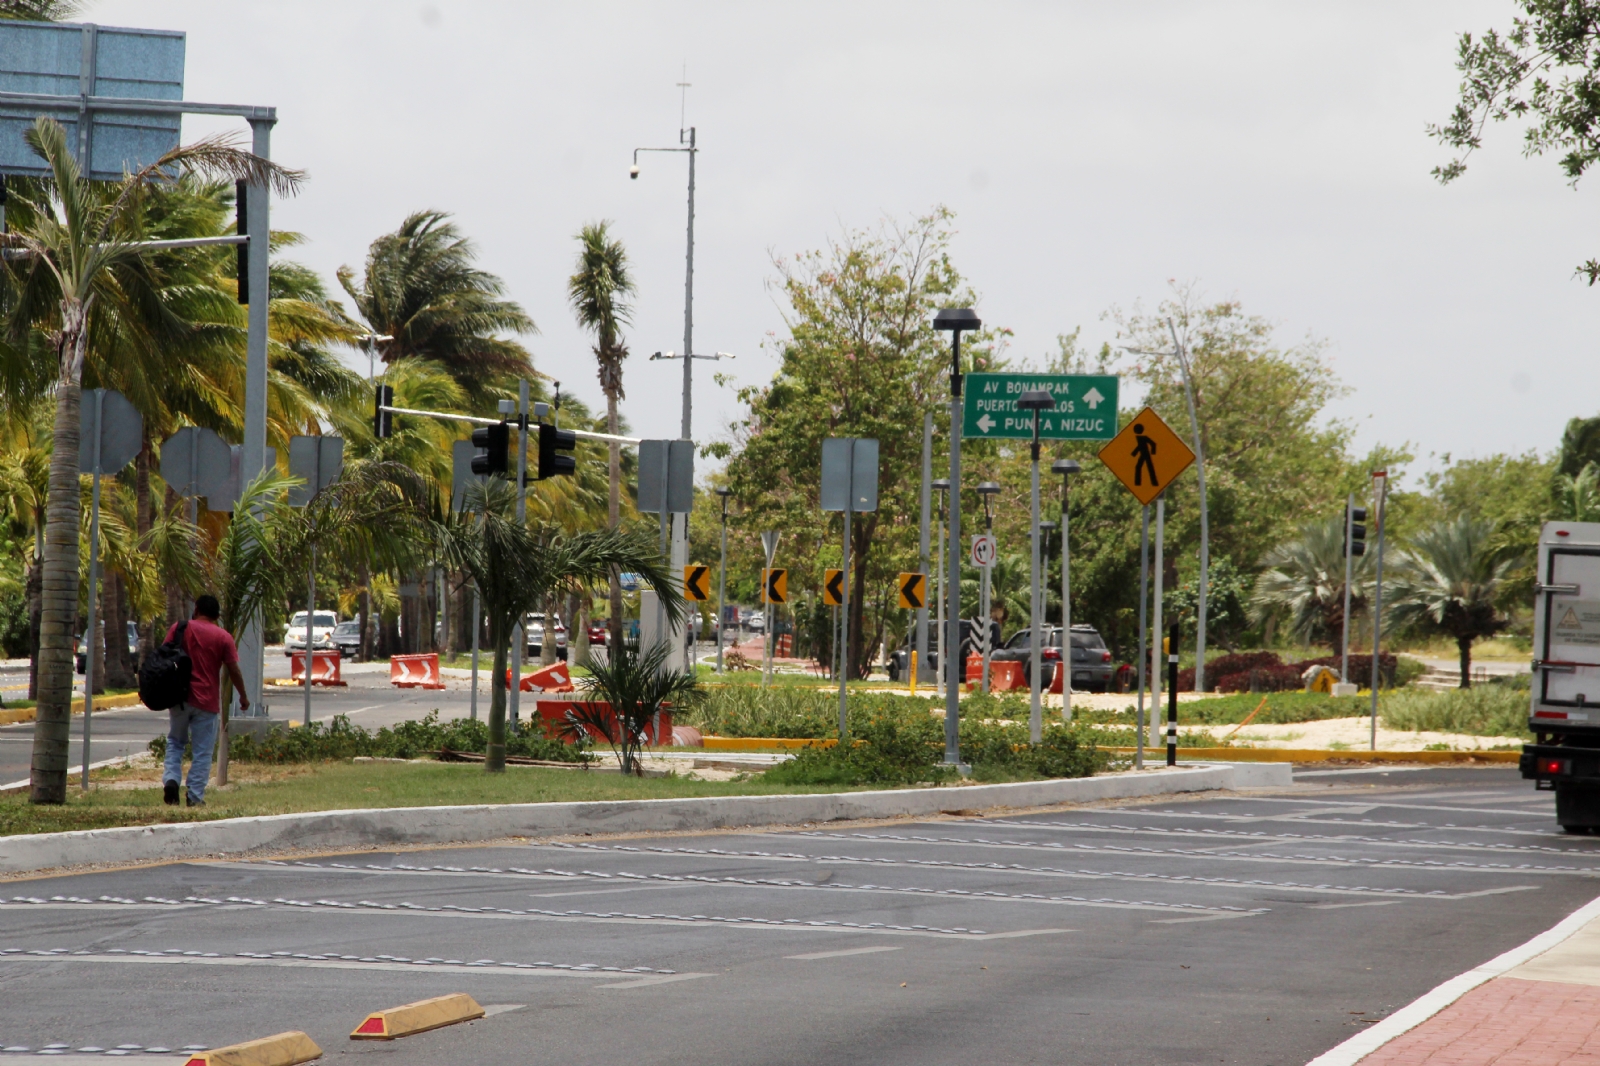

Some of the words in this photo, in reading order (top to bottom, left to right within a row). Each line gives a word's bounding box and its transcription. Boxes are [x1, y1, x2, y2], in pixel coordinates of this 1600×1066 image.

[983, 381, 999, 394] AV
[1006, 381, 1069, 395] BONAMPAK
[1061, 419, 1104, 432] NIZUC
